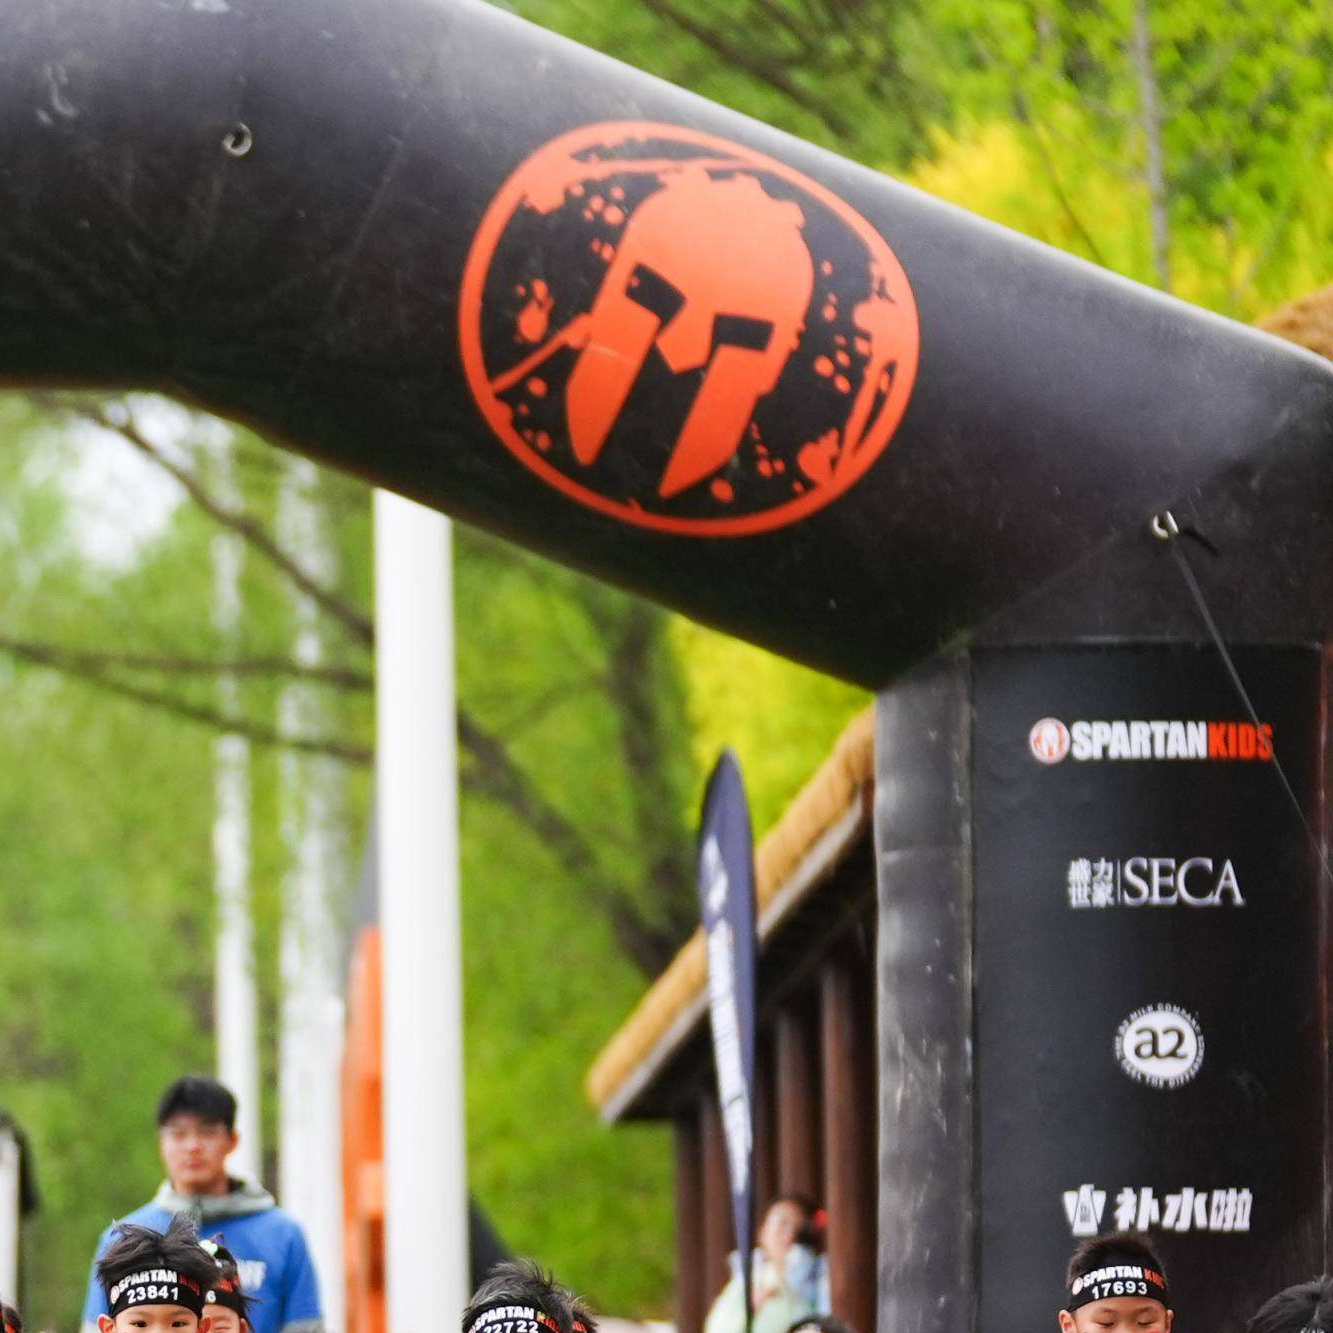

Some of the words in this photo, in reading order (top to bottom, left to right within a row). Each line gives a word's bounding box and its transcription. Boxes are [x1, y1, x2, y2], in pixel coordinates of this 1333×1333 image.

[1123, 857, 1245, 906] SECA
[1134, 1026, 1189, 1060] a2
[1114, 1186, 1253, 1232] 补水啦
[118, 1269, 178, 1295] SPARTAN
[1082, 1265, 1144, 1288] SPARTAN
[1091, 1280, 1148, 1299] 17693
[126, 1285, 179, 1305] 23841
[475, 1305, 535, 1332] SPARTAN
